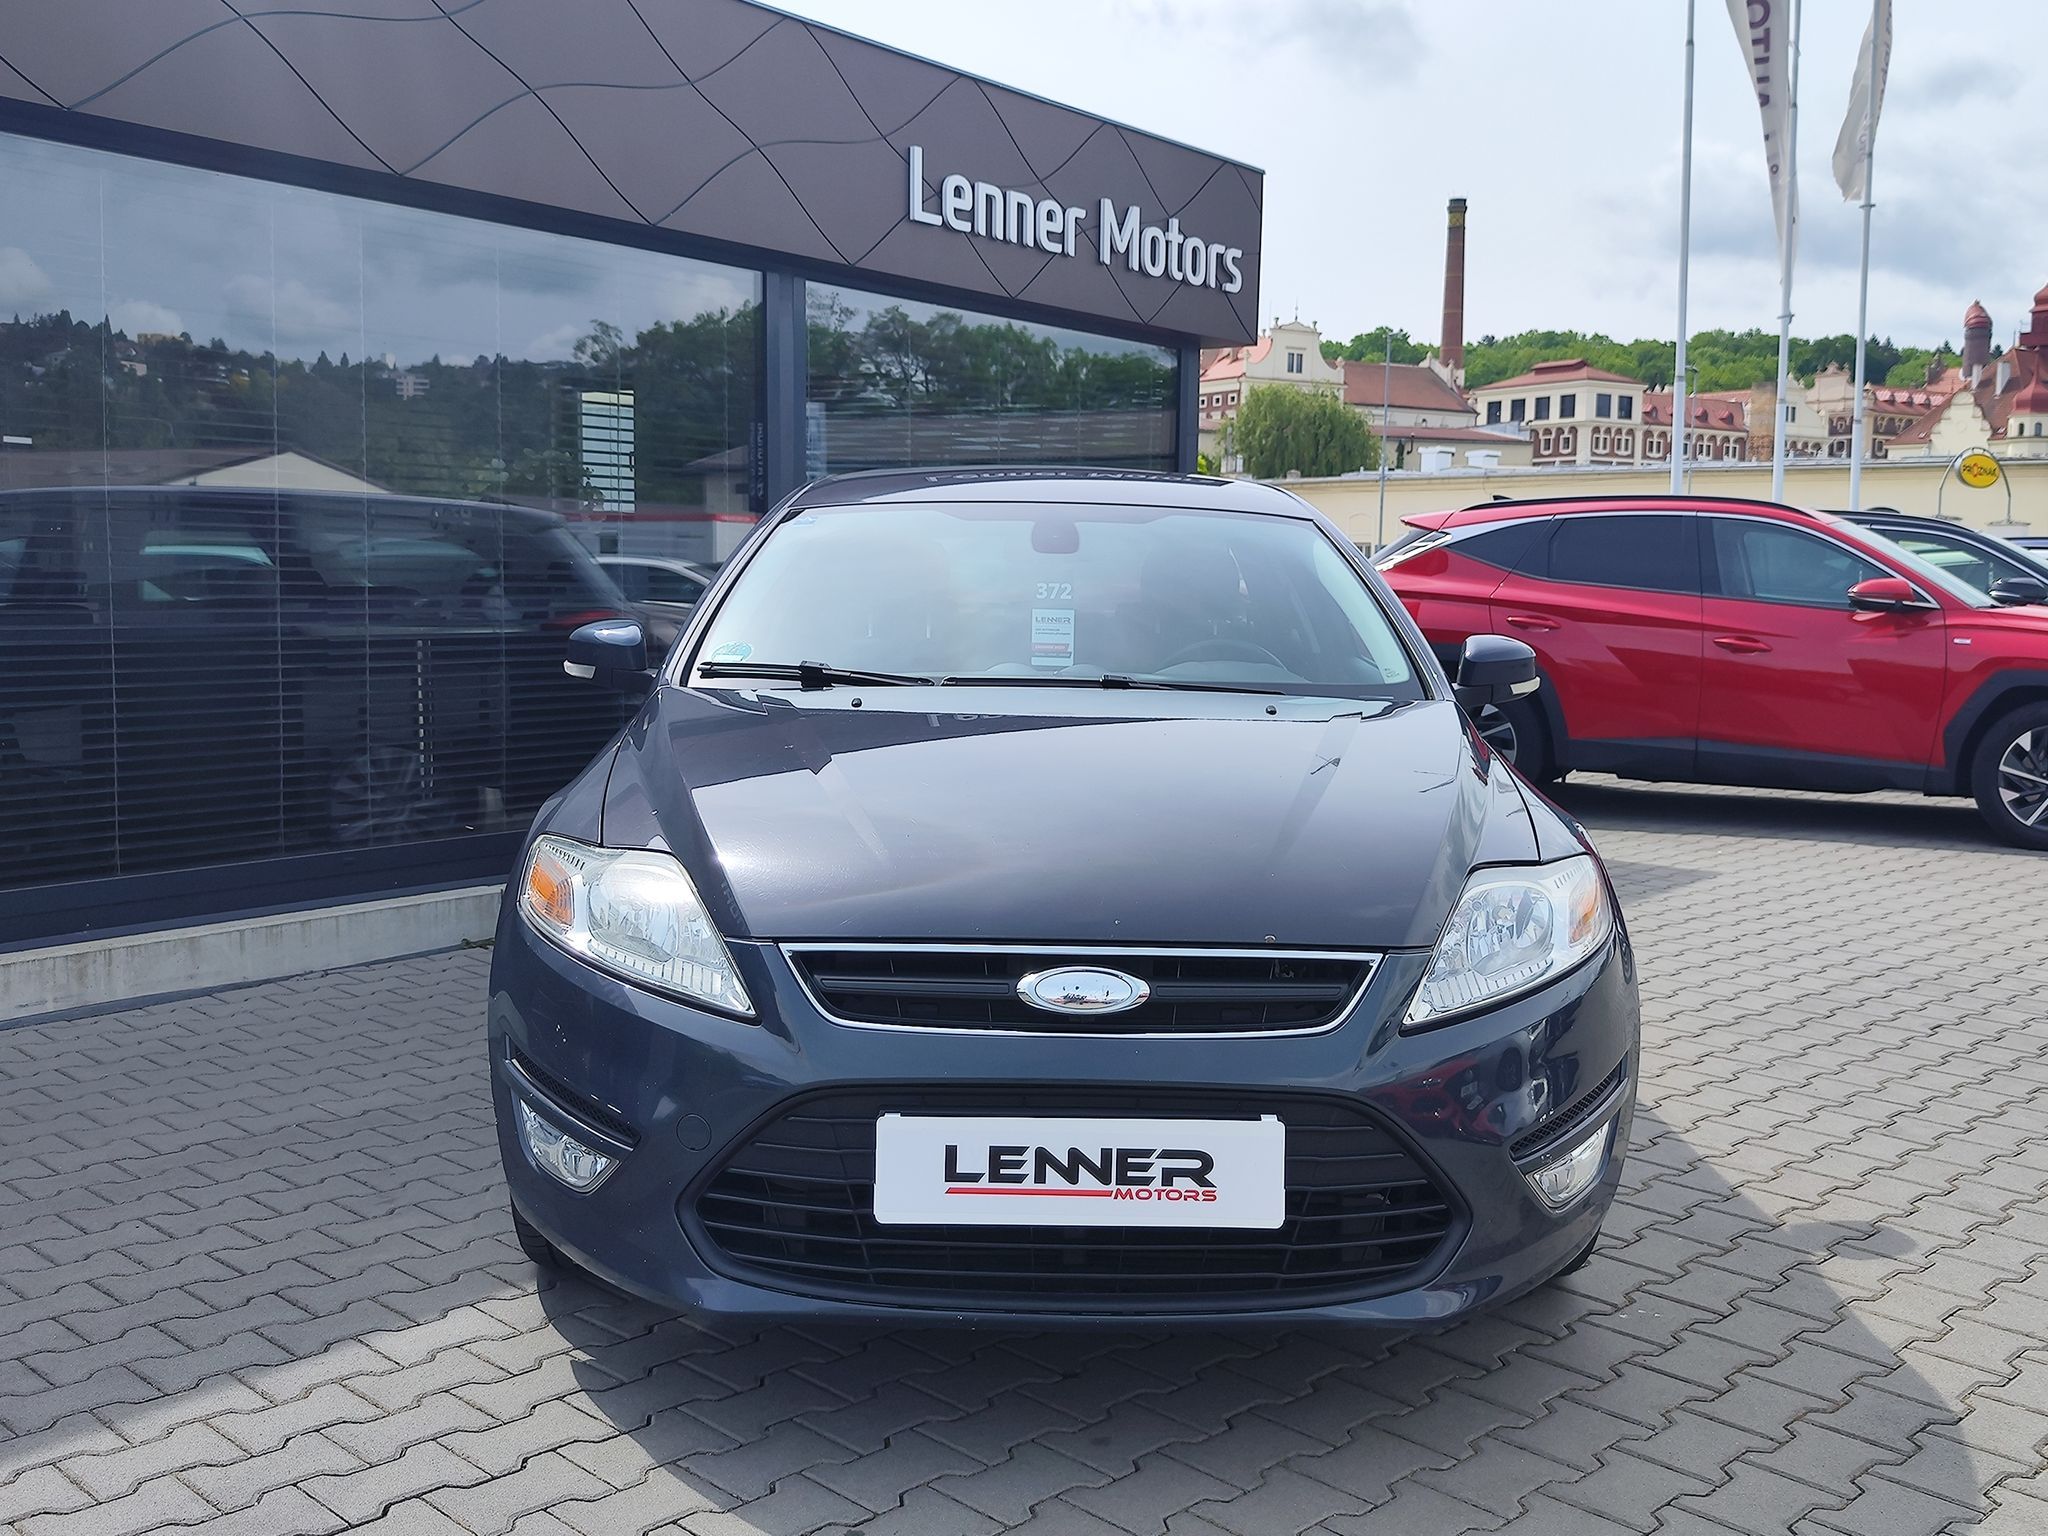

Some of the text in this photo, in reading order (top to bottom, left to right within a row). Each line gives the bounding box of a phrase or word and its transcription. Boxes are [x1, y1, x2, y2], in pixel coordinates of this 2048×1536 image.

[909, 145, 1244, 294] Lenner Motors
[1036, 582, 1072, 600] 372
[944, 1144, 1217, 1188] LENNER
[1112, 1187, 1217, 1202] MOTORS
